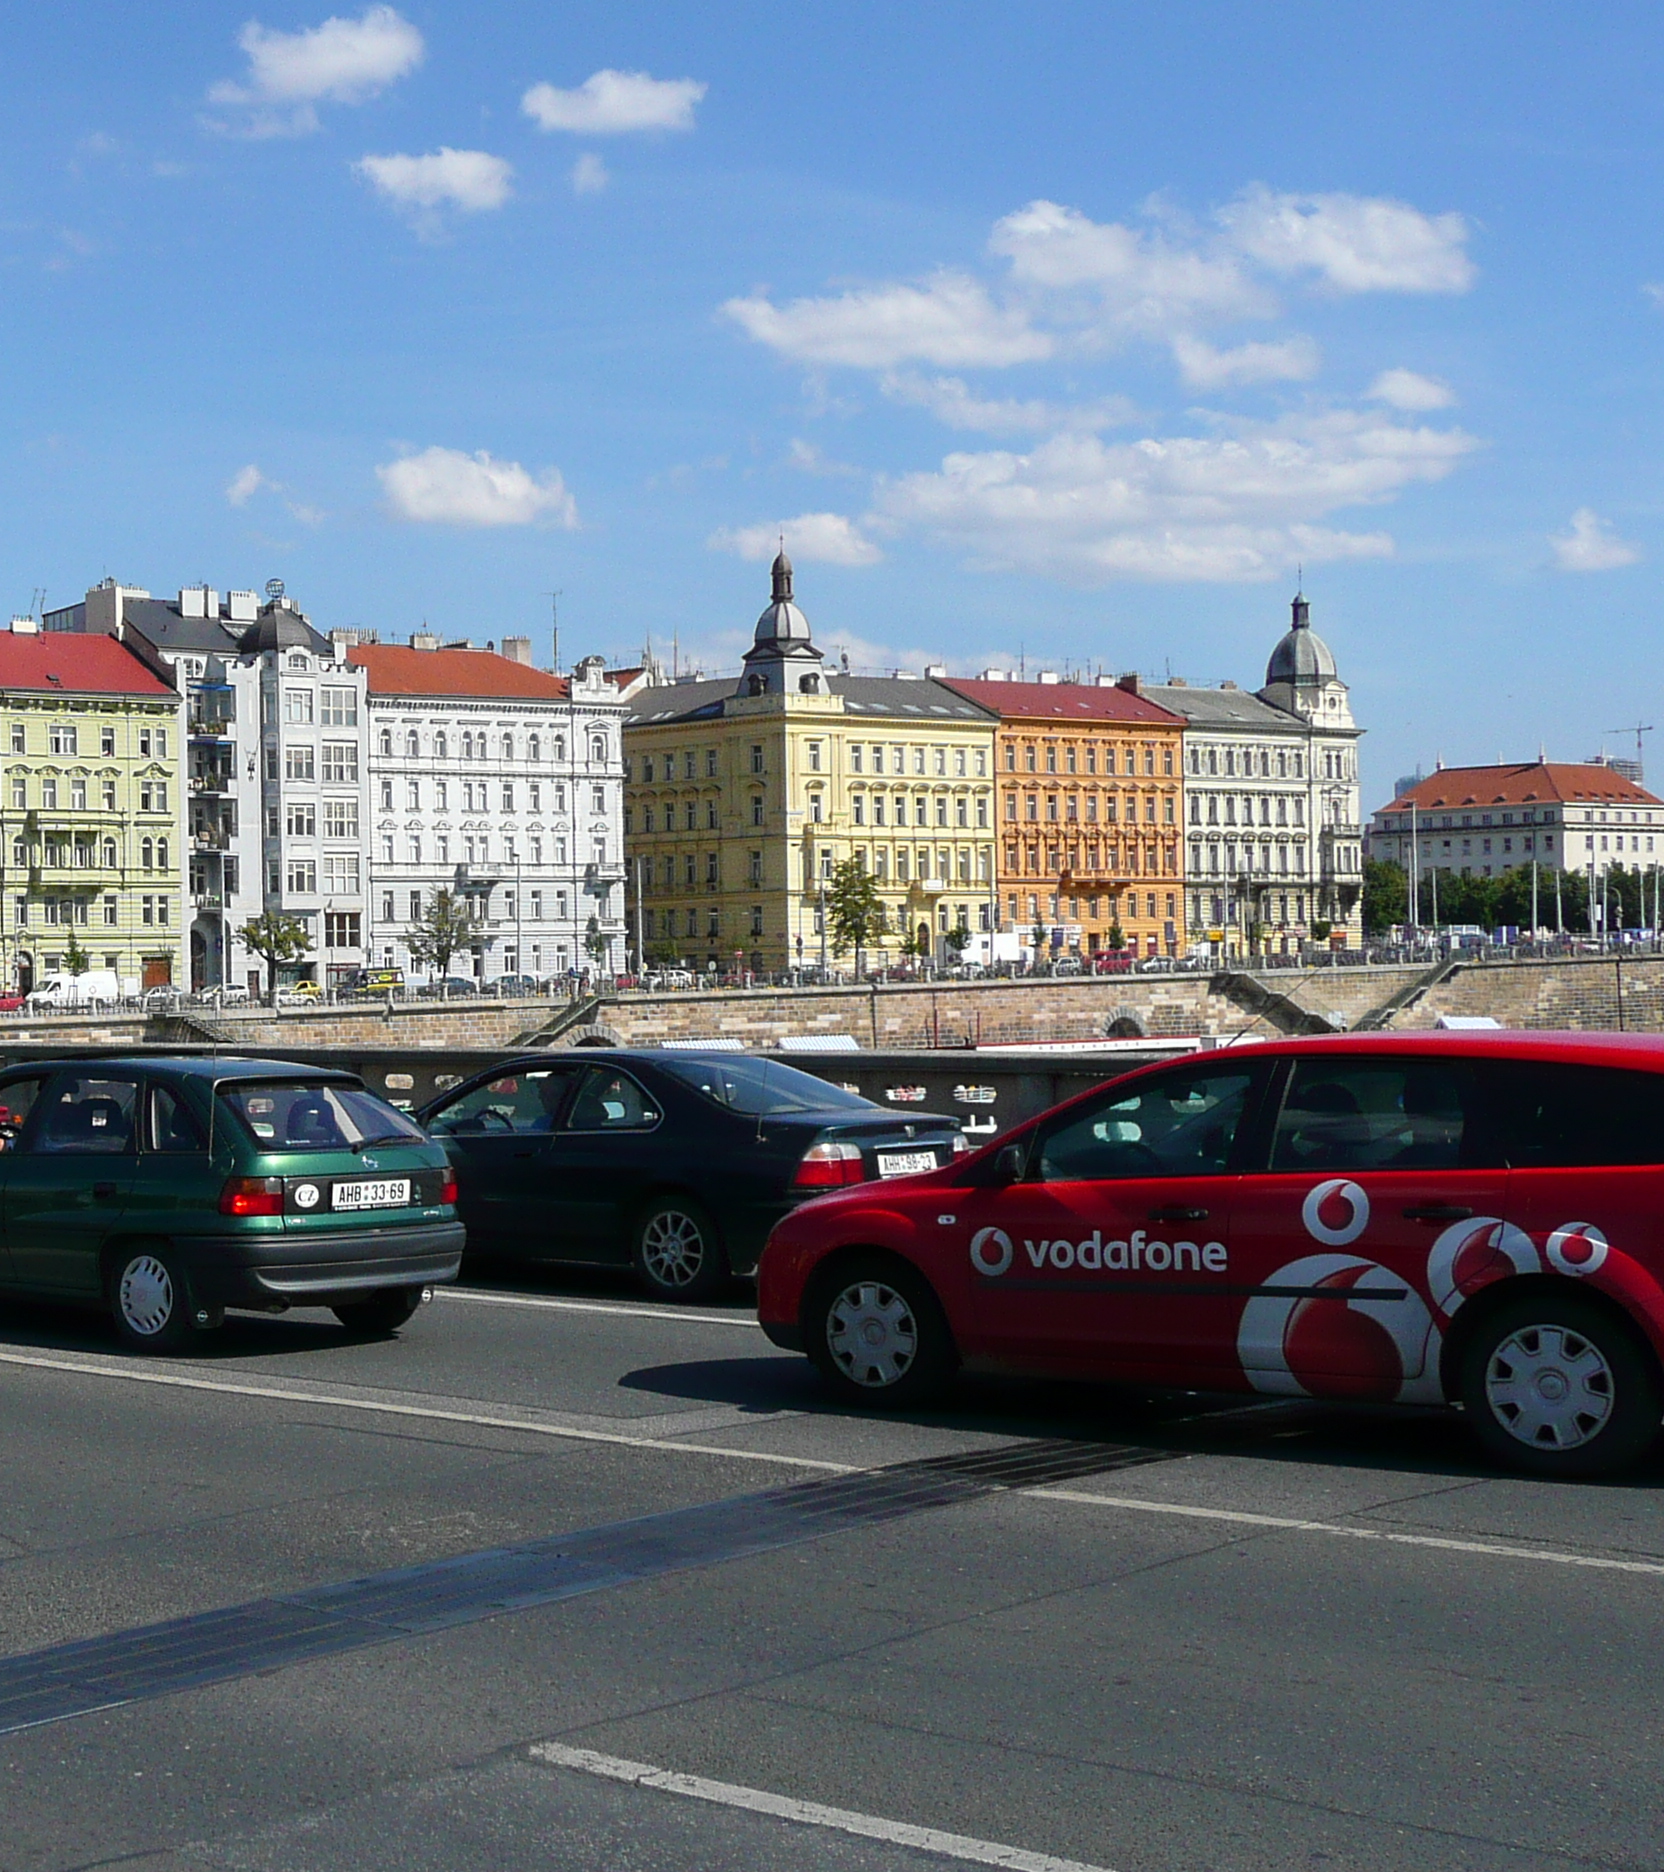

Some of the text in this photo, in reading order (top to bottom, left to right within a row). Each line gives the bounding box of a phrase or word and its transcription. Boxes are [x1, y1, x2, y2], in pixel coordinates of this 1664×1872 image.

[297, 1189, 316, 1203] CZ
[338, 1185, 362, 1203] AHB
[1023, 1230, 1229, 1272] vodafone
